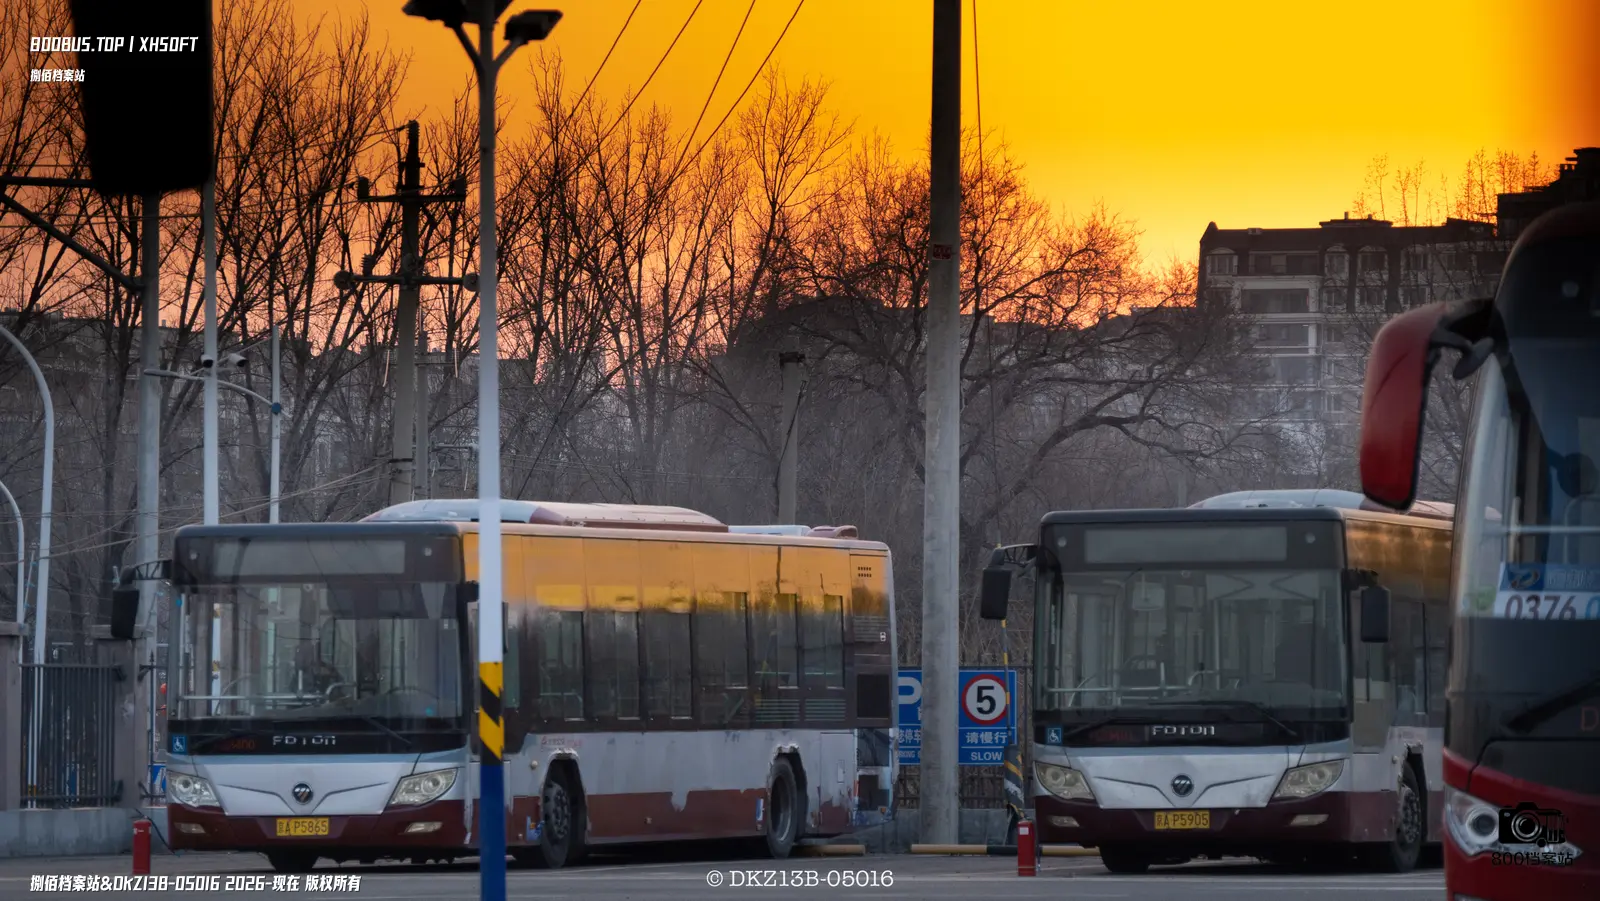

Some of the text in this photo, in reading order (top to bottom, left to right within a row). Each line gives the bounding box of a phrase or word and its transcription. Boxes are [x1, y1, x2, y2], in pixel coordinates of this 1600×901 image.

[1504, 594, 1578, 620] 0376
[976, 685, 996, 715] 5
[1152, 725, 1215, 736] FOTON
[272, 735, 337, 746] FOTON
[966, 731, 1008, 744] 请慢行
[970, 751, 1003, 761] SLOW
